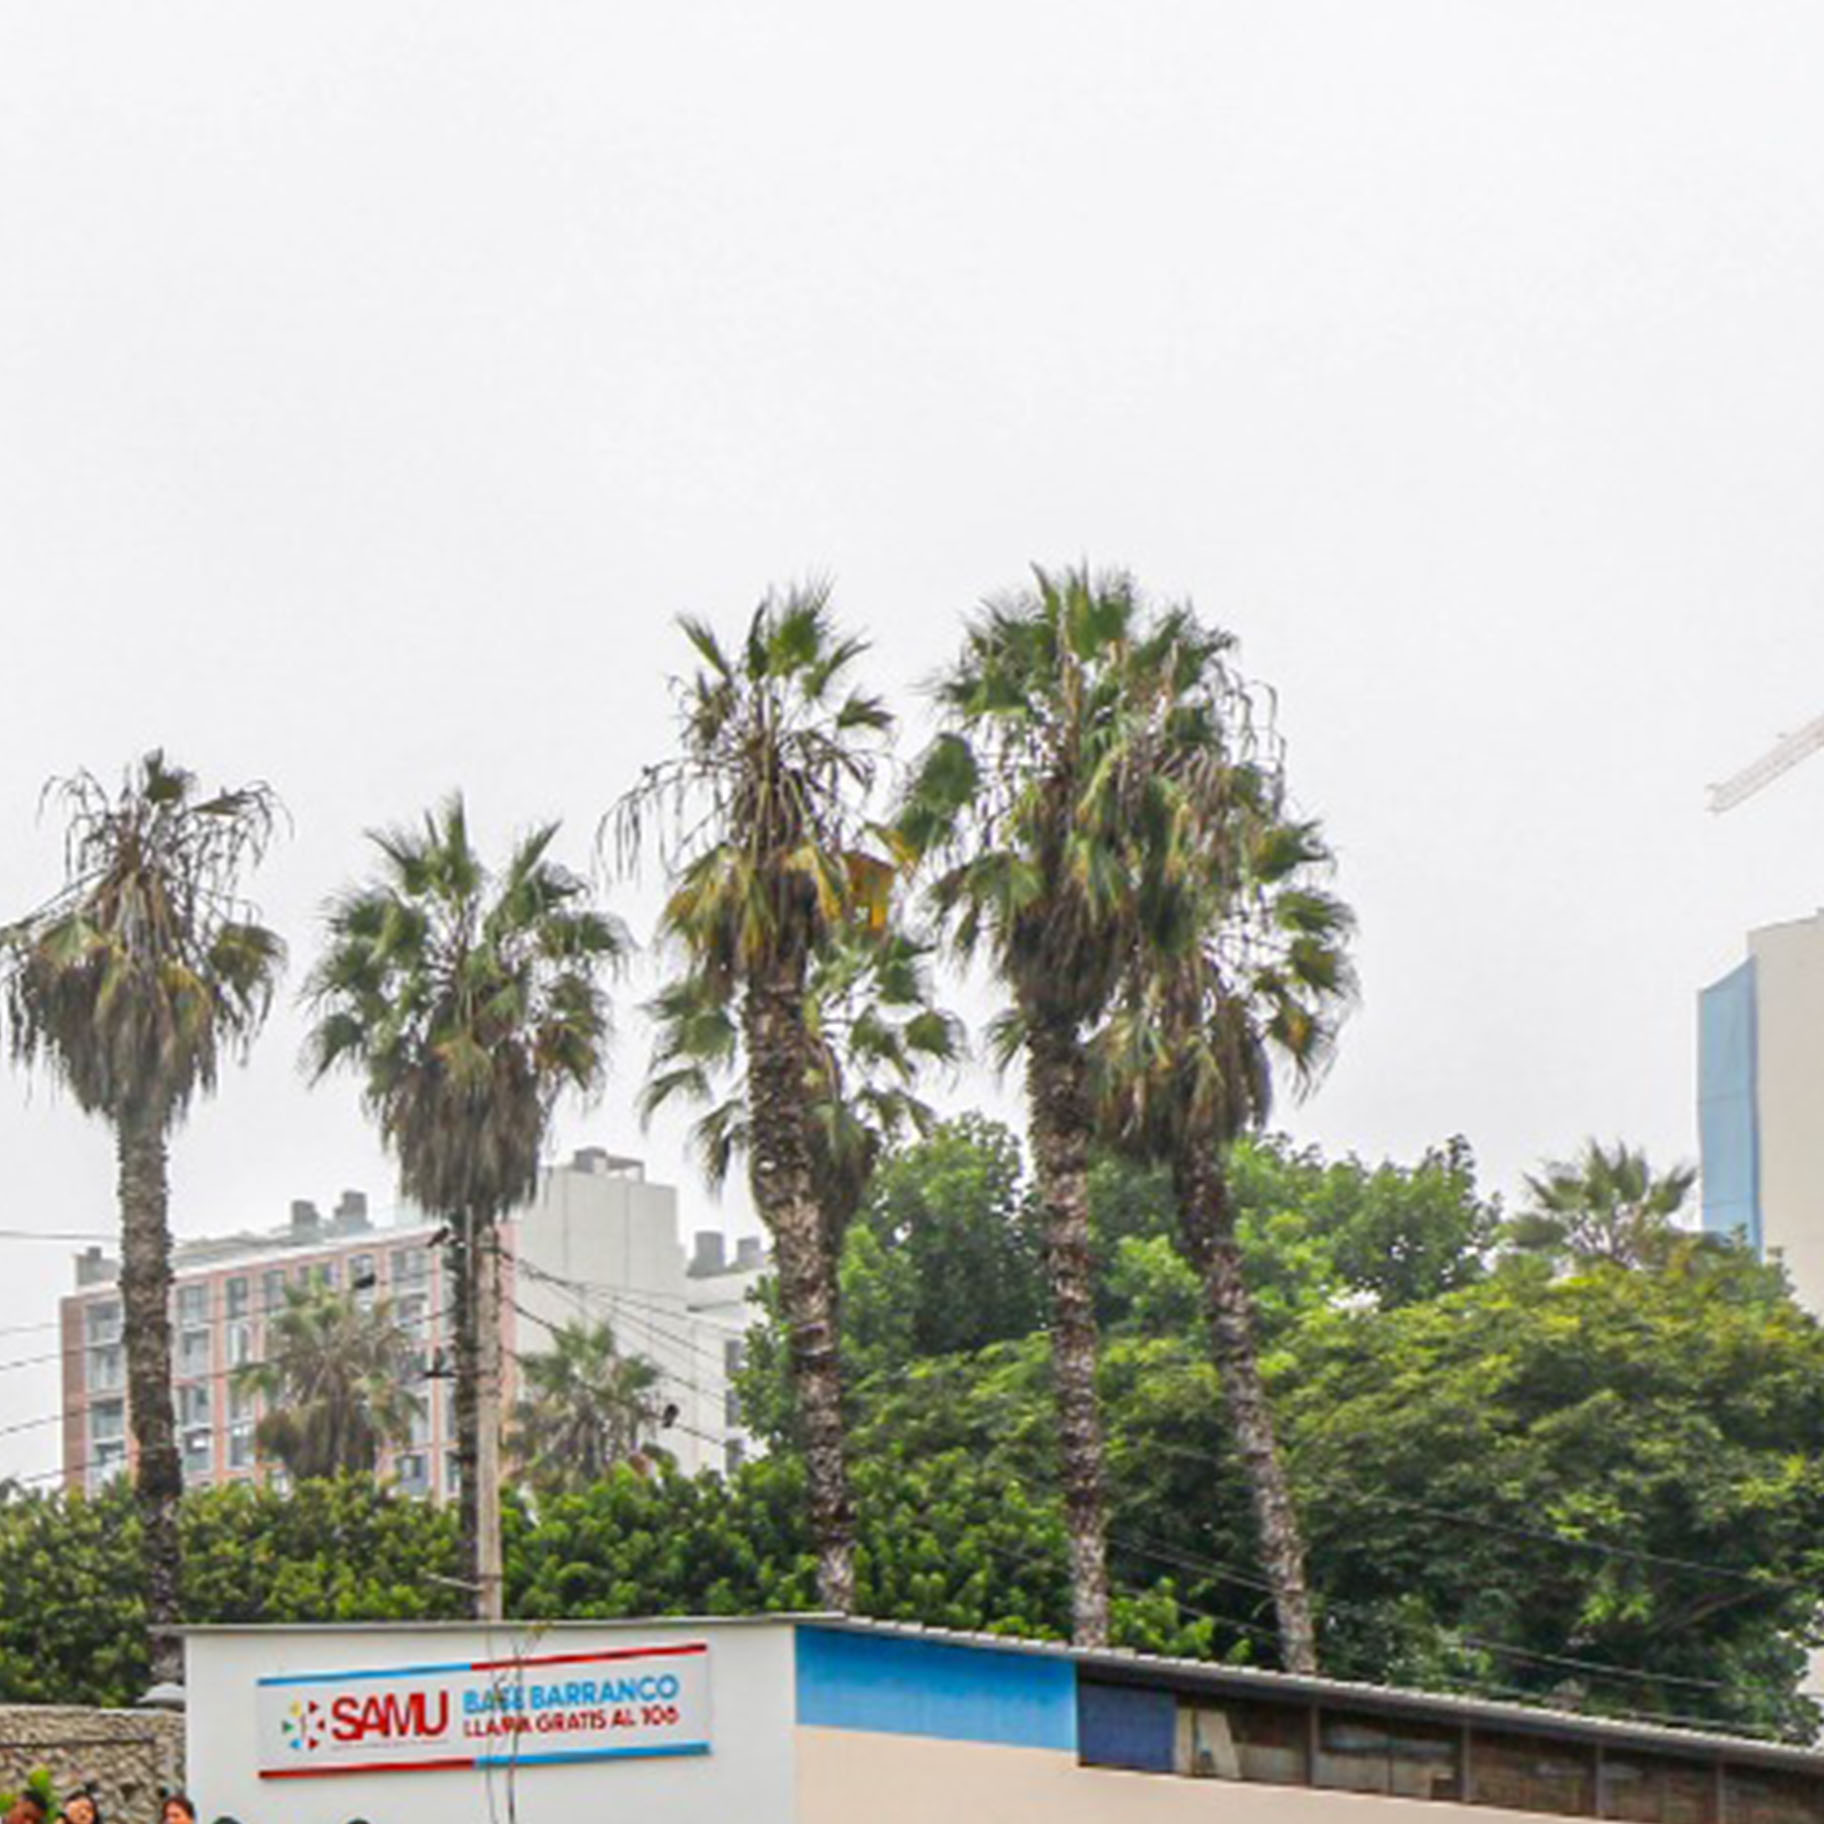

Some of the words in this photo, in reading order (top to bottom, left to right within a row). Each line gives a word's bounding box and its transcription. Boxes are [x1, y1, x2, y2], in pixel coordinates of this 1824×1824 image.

[463, 1685, 524, 1714] BASE
[531, 1675, 680, 1710] BARRANCO
[332, 1690, 448, 1741] SAMU
[463, 1714, 532, 1738] LLAMA
[536, 1707, 606, 1734] GRATIS
[612, 1707, 637, 1728] AL
[639, 1703, 680, 1726] 106
